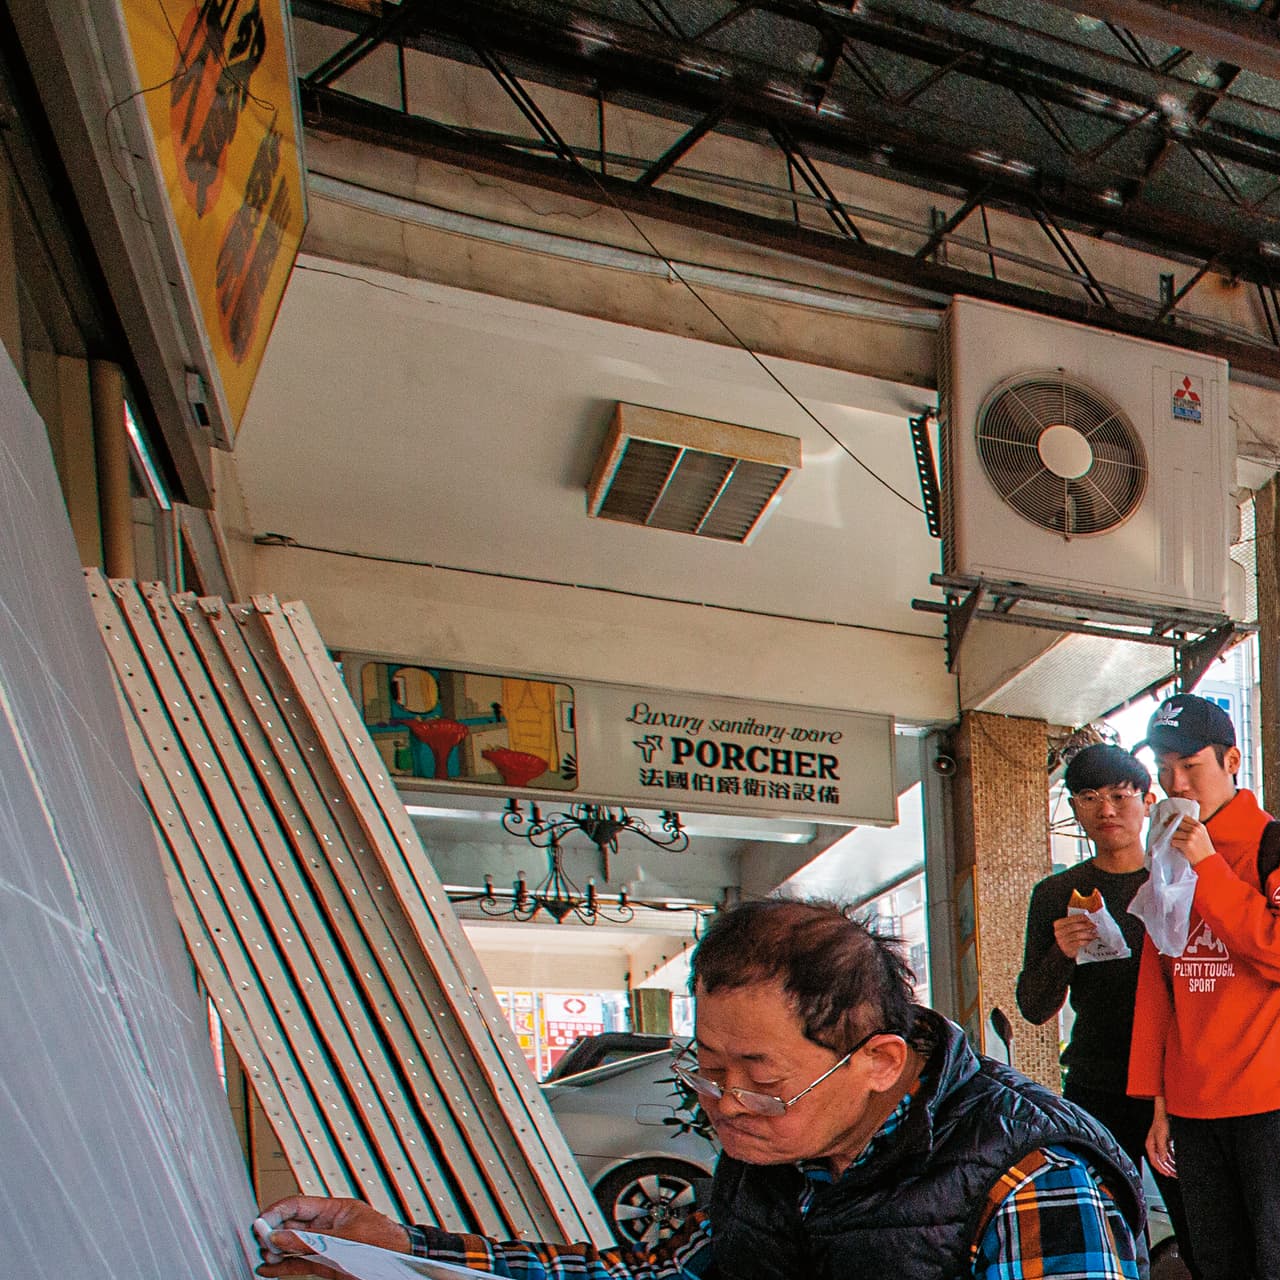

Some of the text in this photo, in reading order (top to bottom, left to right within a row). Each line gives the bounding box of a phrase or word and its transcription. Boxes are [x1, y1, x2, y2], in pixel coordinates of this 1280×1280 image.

[625, 702, 843, 745] Luxury sanitary-ware
[669, 736, 841, 780] PORCHER
[1189, 978, 1217, 992] SPORT
